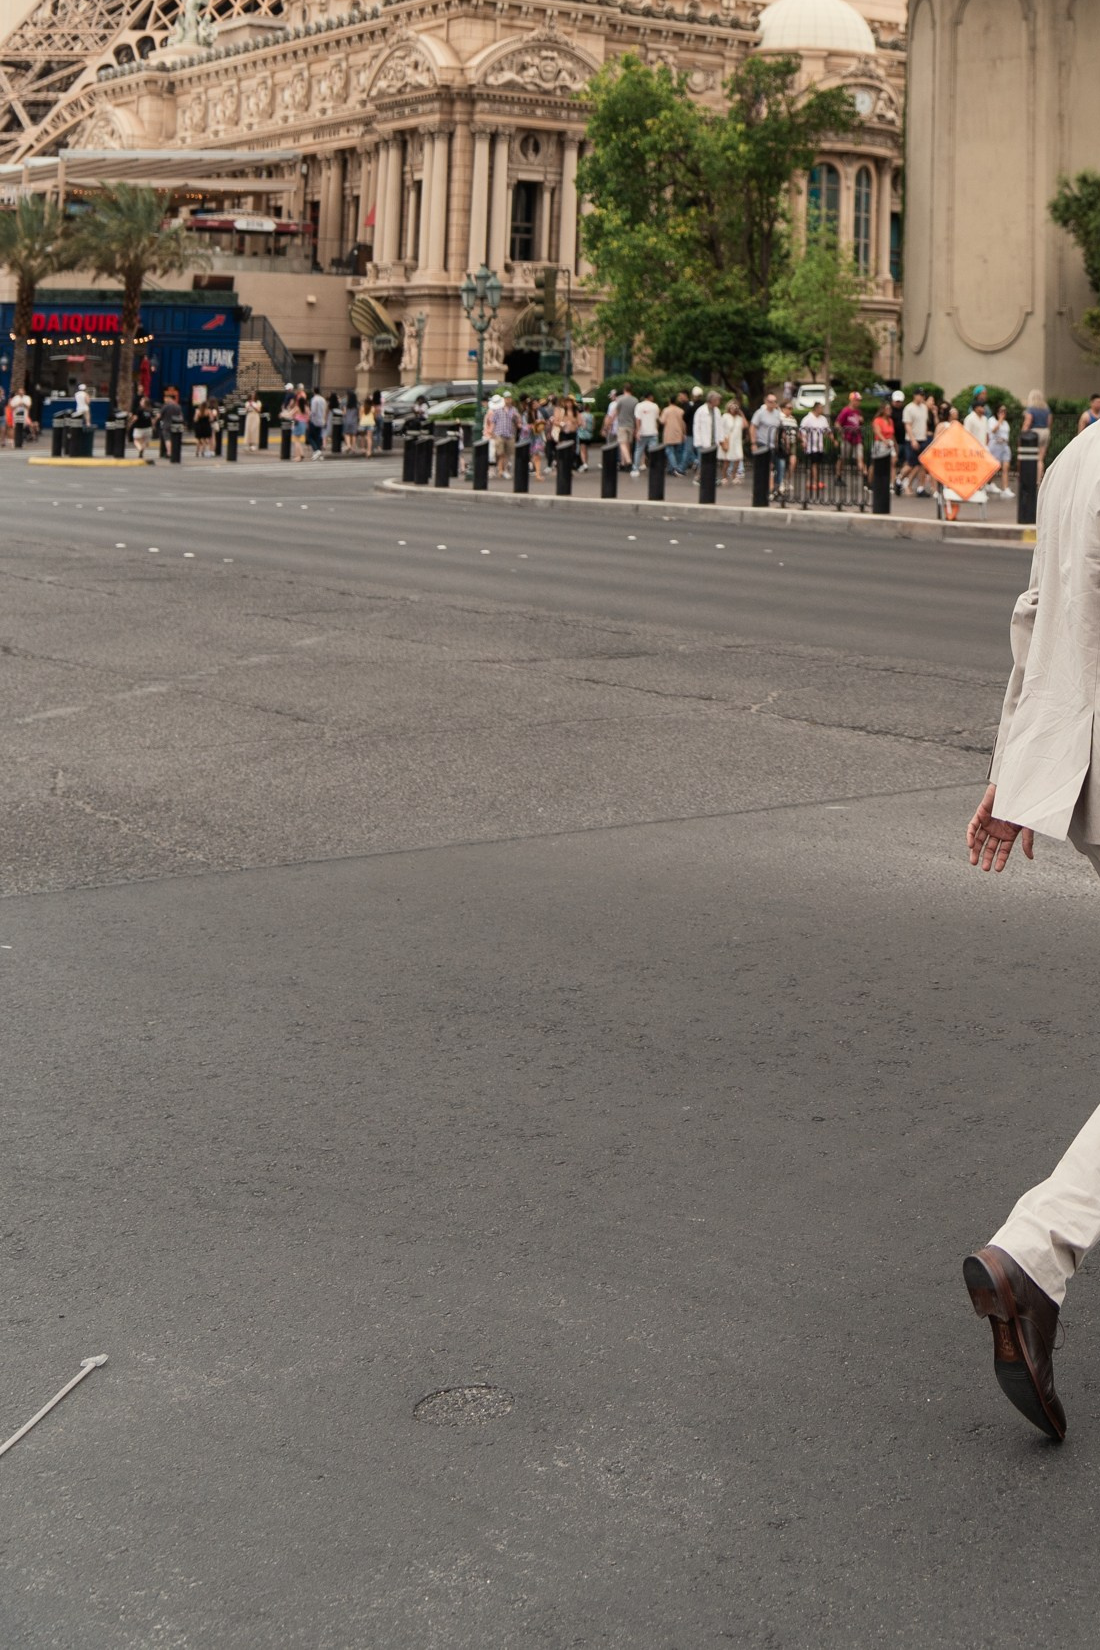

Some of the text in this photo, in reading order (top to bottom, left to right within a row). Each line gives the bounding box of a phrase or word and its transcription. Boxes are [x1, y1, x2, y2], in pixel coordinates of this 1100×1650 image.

[187, 348, 234, 369] BEER PARK
[944, 461, 978, 472] CLOSED
